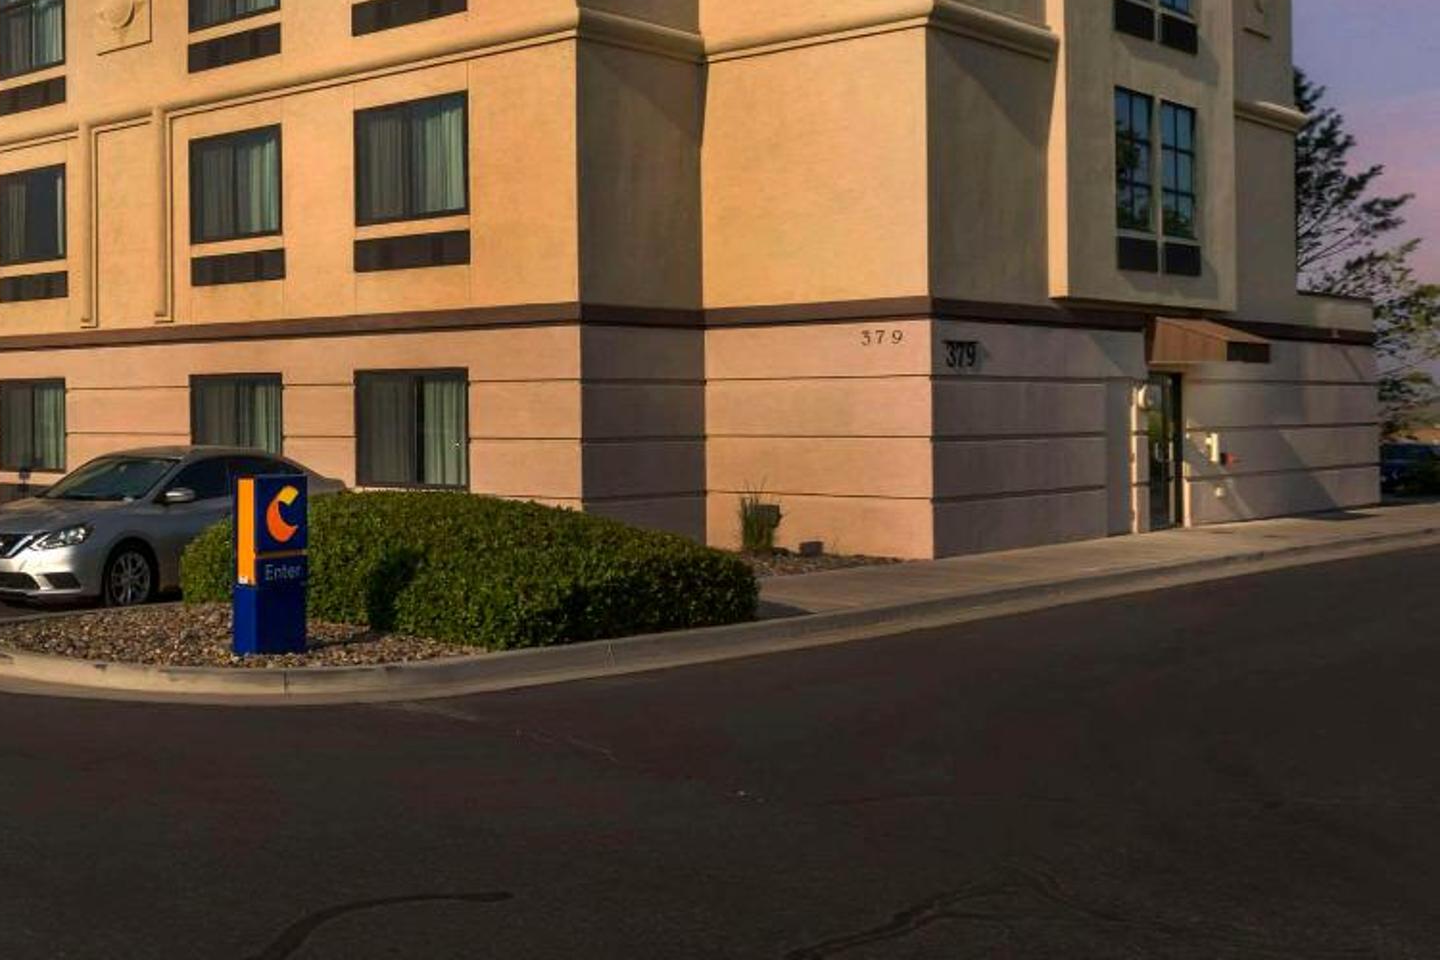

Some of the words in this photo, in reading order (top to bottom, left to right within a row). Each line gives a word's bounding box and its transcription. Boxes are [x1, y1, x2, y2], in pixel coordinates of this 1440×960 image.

[861, 329, 903, 346] 379
[945, 341, 977, 368] 379
[264, 563, 302, 581] Enter
